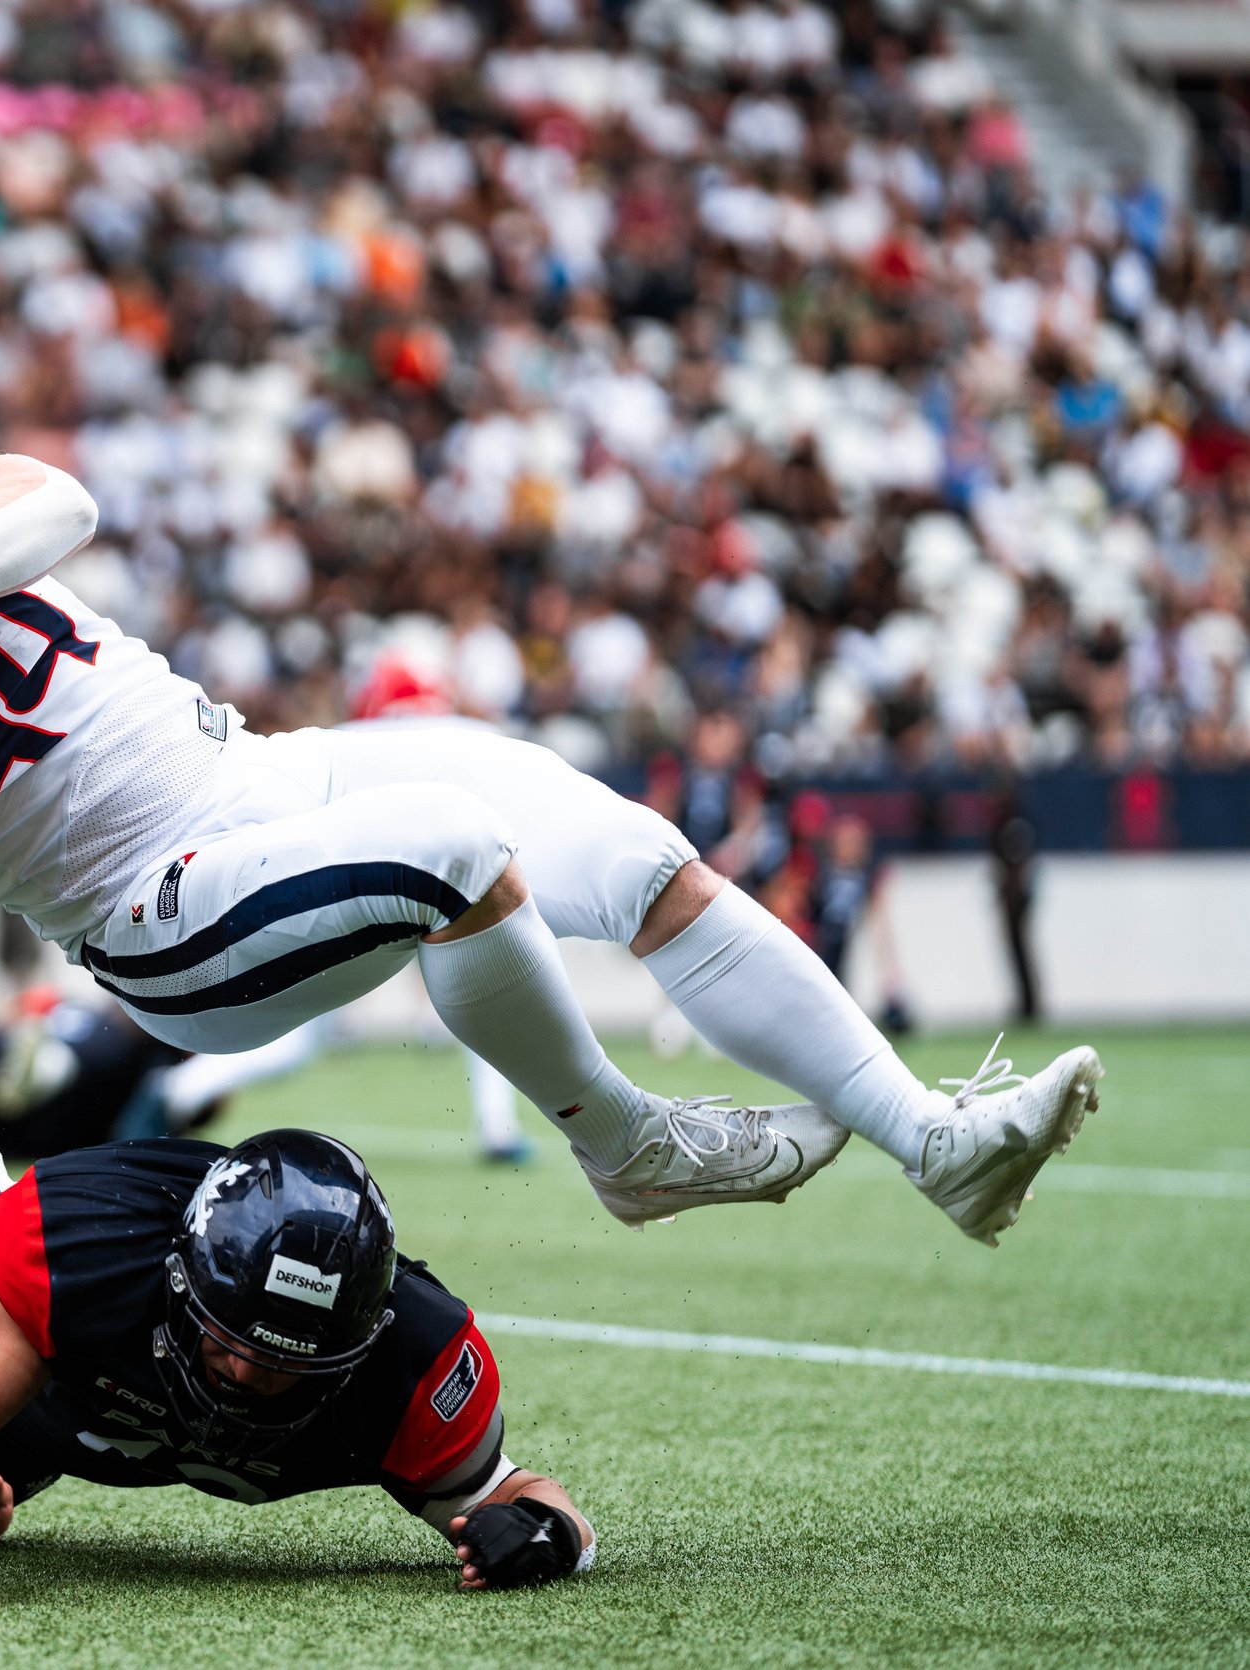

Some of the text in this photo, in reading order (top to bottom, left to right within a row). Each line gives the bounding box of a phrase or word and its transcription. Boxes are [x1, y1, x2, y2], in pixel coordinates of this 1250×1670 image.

[159, 879, 169, 918] EUROPEAN
[170, 877, 178, 916] FOOTBALL
[275, 1269, 333, 1295] DEFSHOP
[252, 1325, 318, 1355] FORELLE
[435, 1371, 462, 1405] EUROPEAN
[439, 1388, 459, 1410] LEAGUE
[444, 1385, 468, 1417] FOOTBALL
